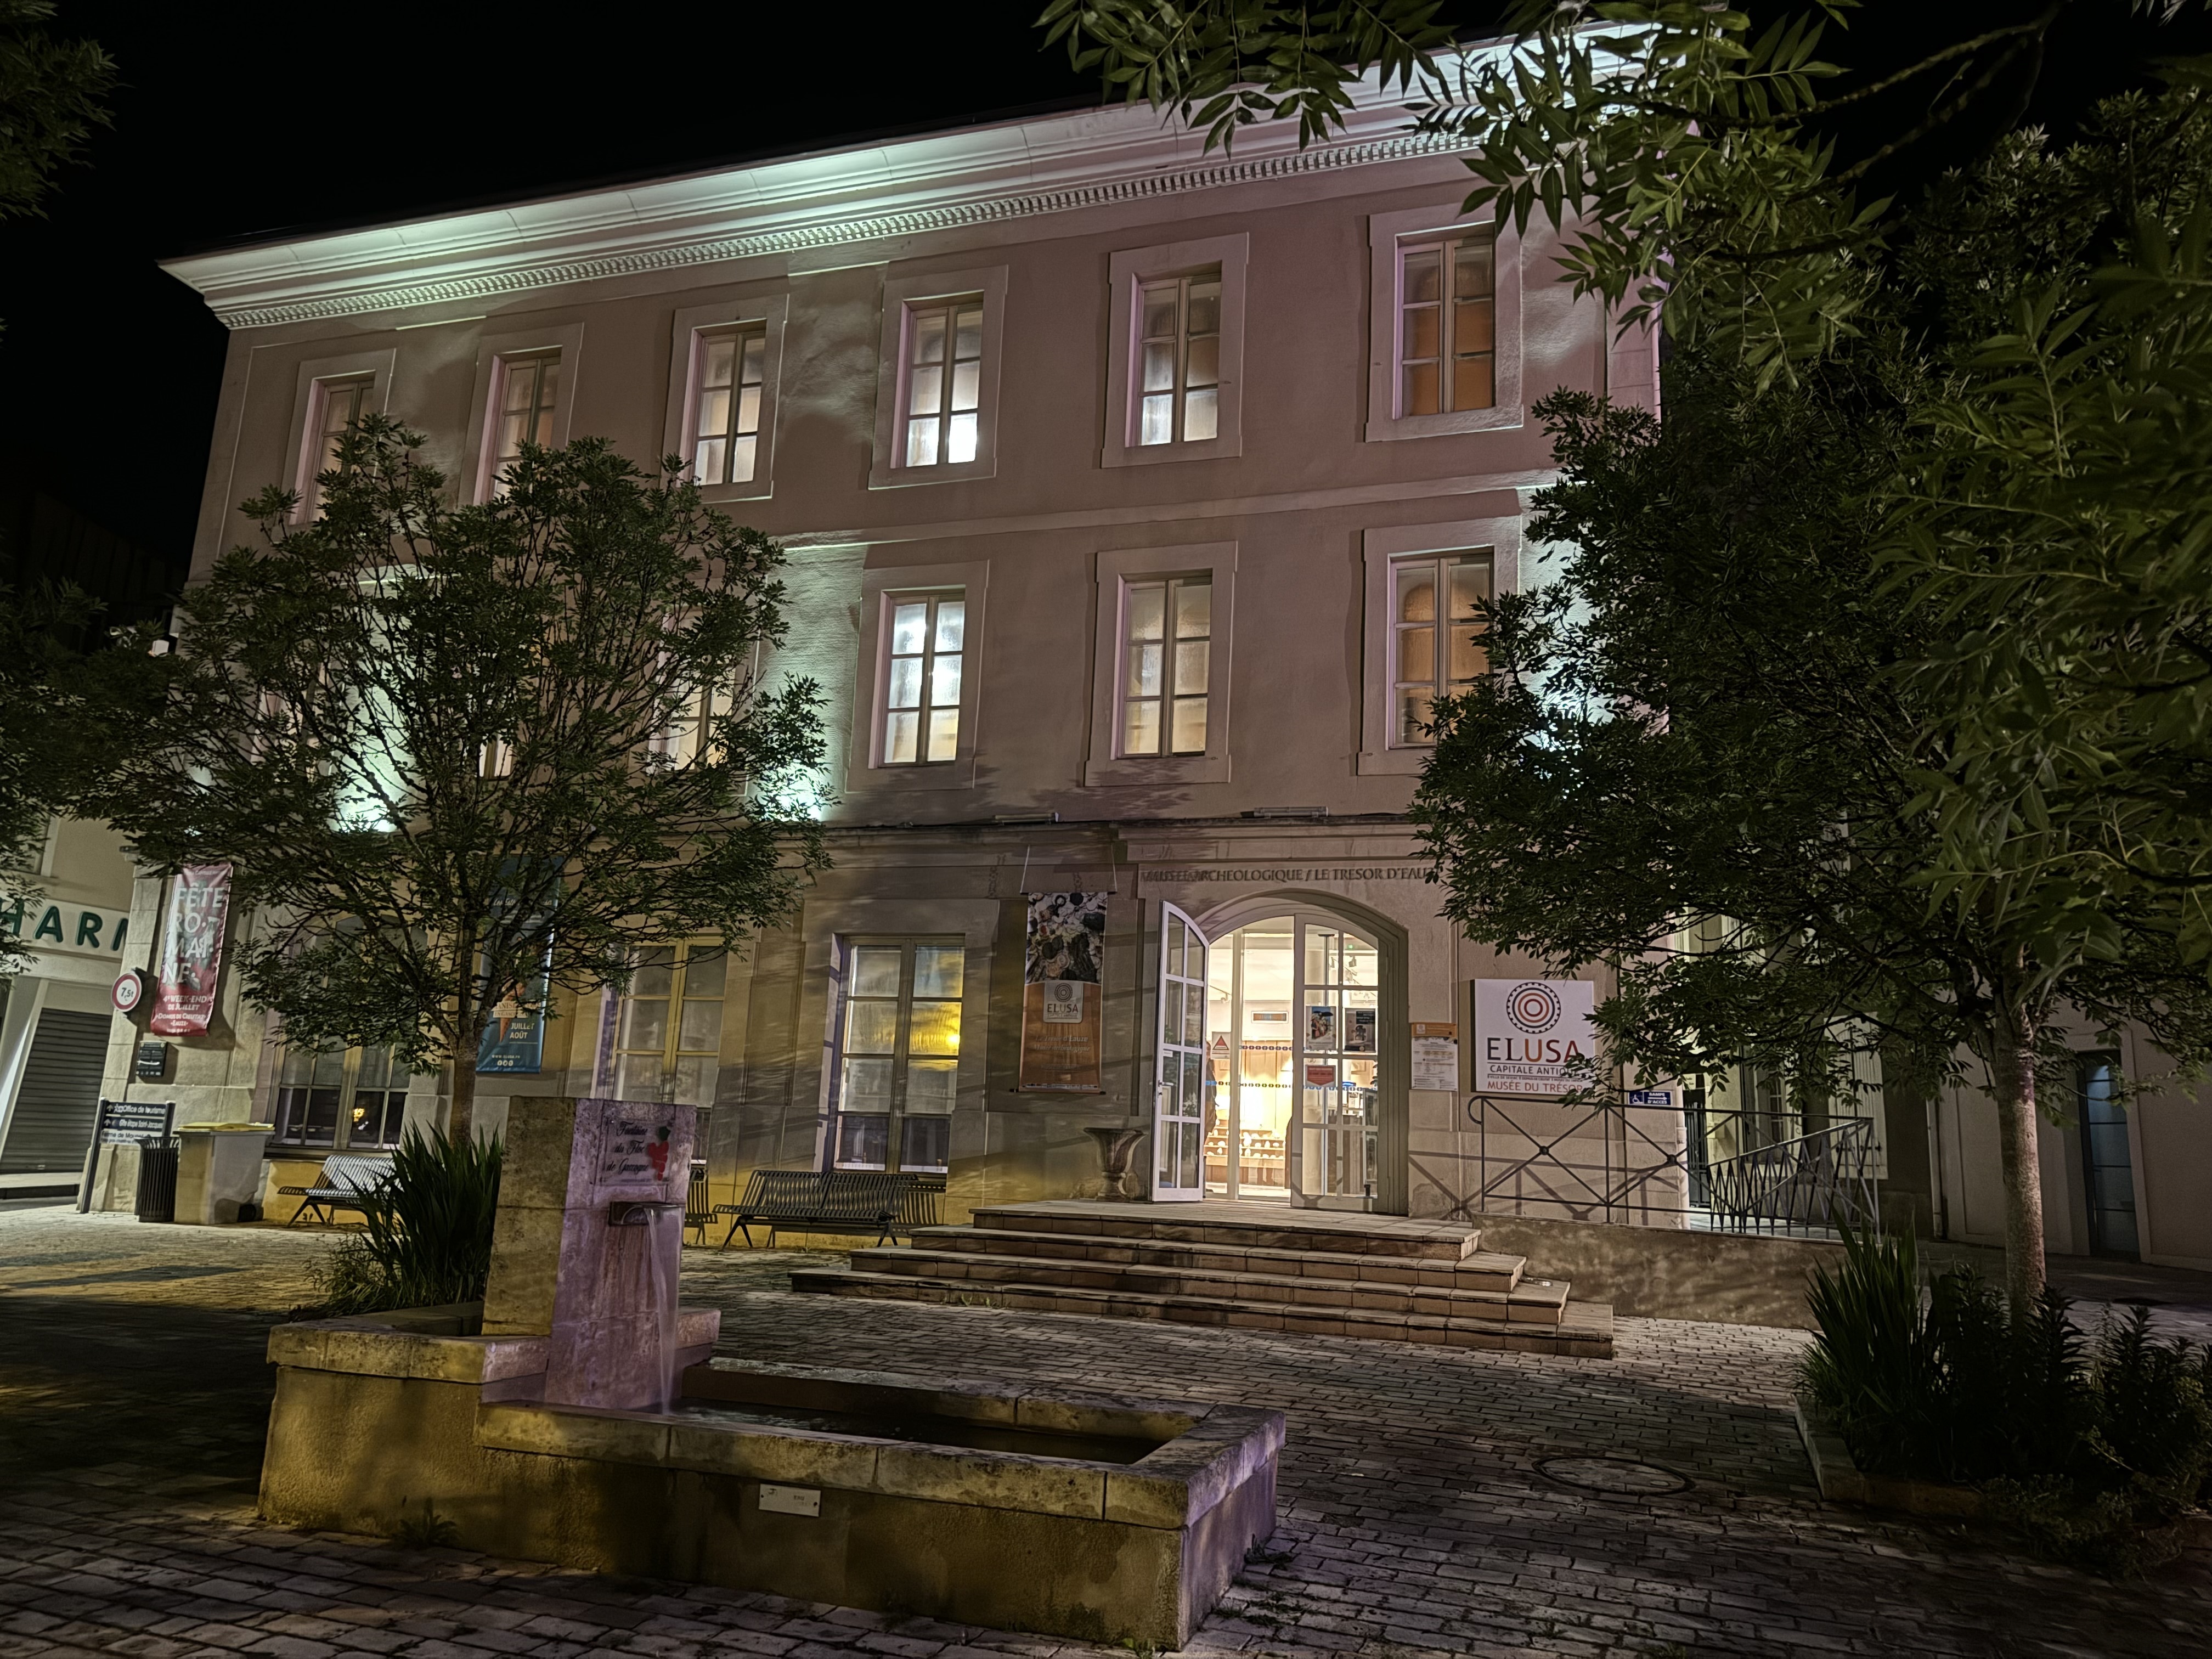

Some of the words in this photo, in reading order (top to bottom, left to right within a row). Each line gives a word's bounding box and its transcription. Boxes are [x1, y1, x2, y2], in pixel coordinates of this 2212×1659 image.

[1315, 869, 1329, 881] LE
[1331, 868, 1383, 881] TRESOR
[1387, 867, 1438, 880] D'EAU
[177, 882, 224, 907] FÊTE
[1047, 1003, 1079, 1013] ELUSA
[1487, 1037, 1581, 1063] ELUSA
[1490, 1065, 1533, 1074] CAPITALE
[1487, 1080, 1521, 1091] MUSÉE
[1525, 1082, 1539, 1092] DU
